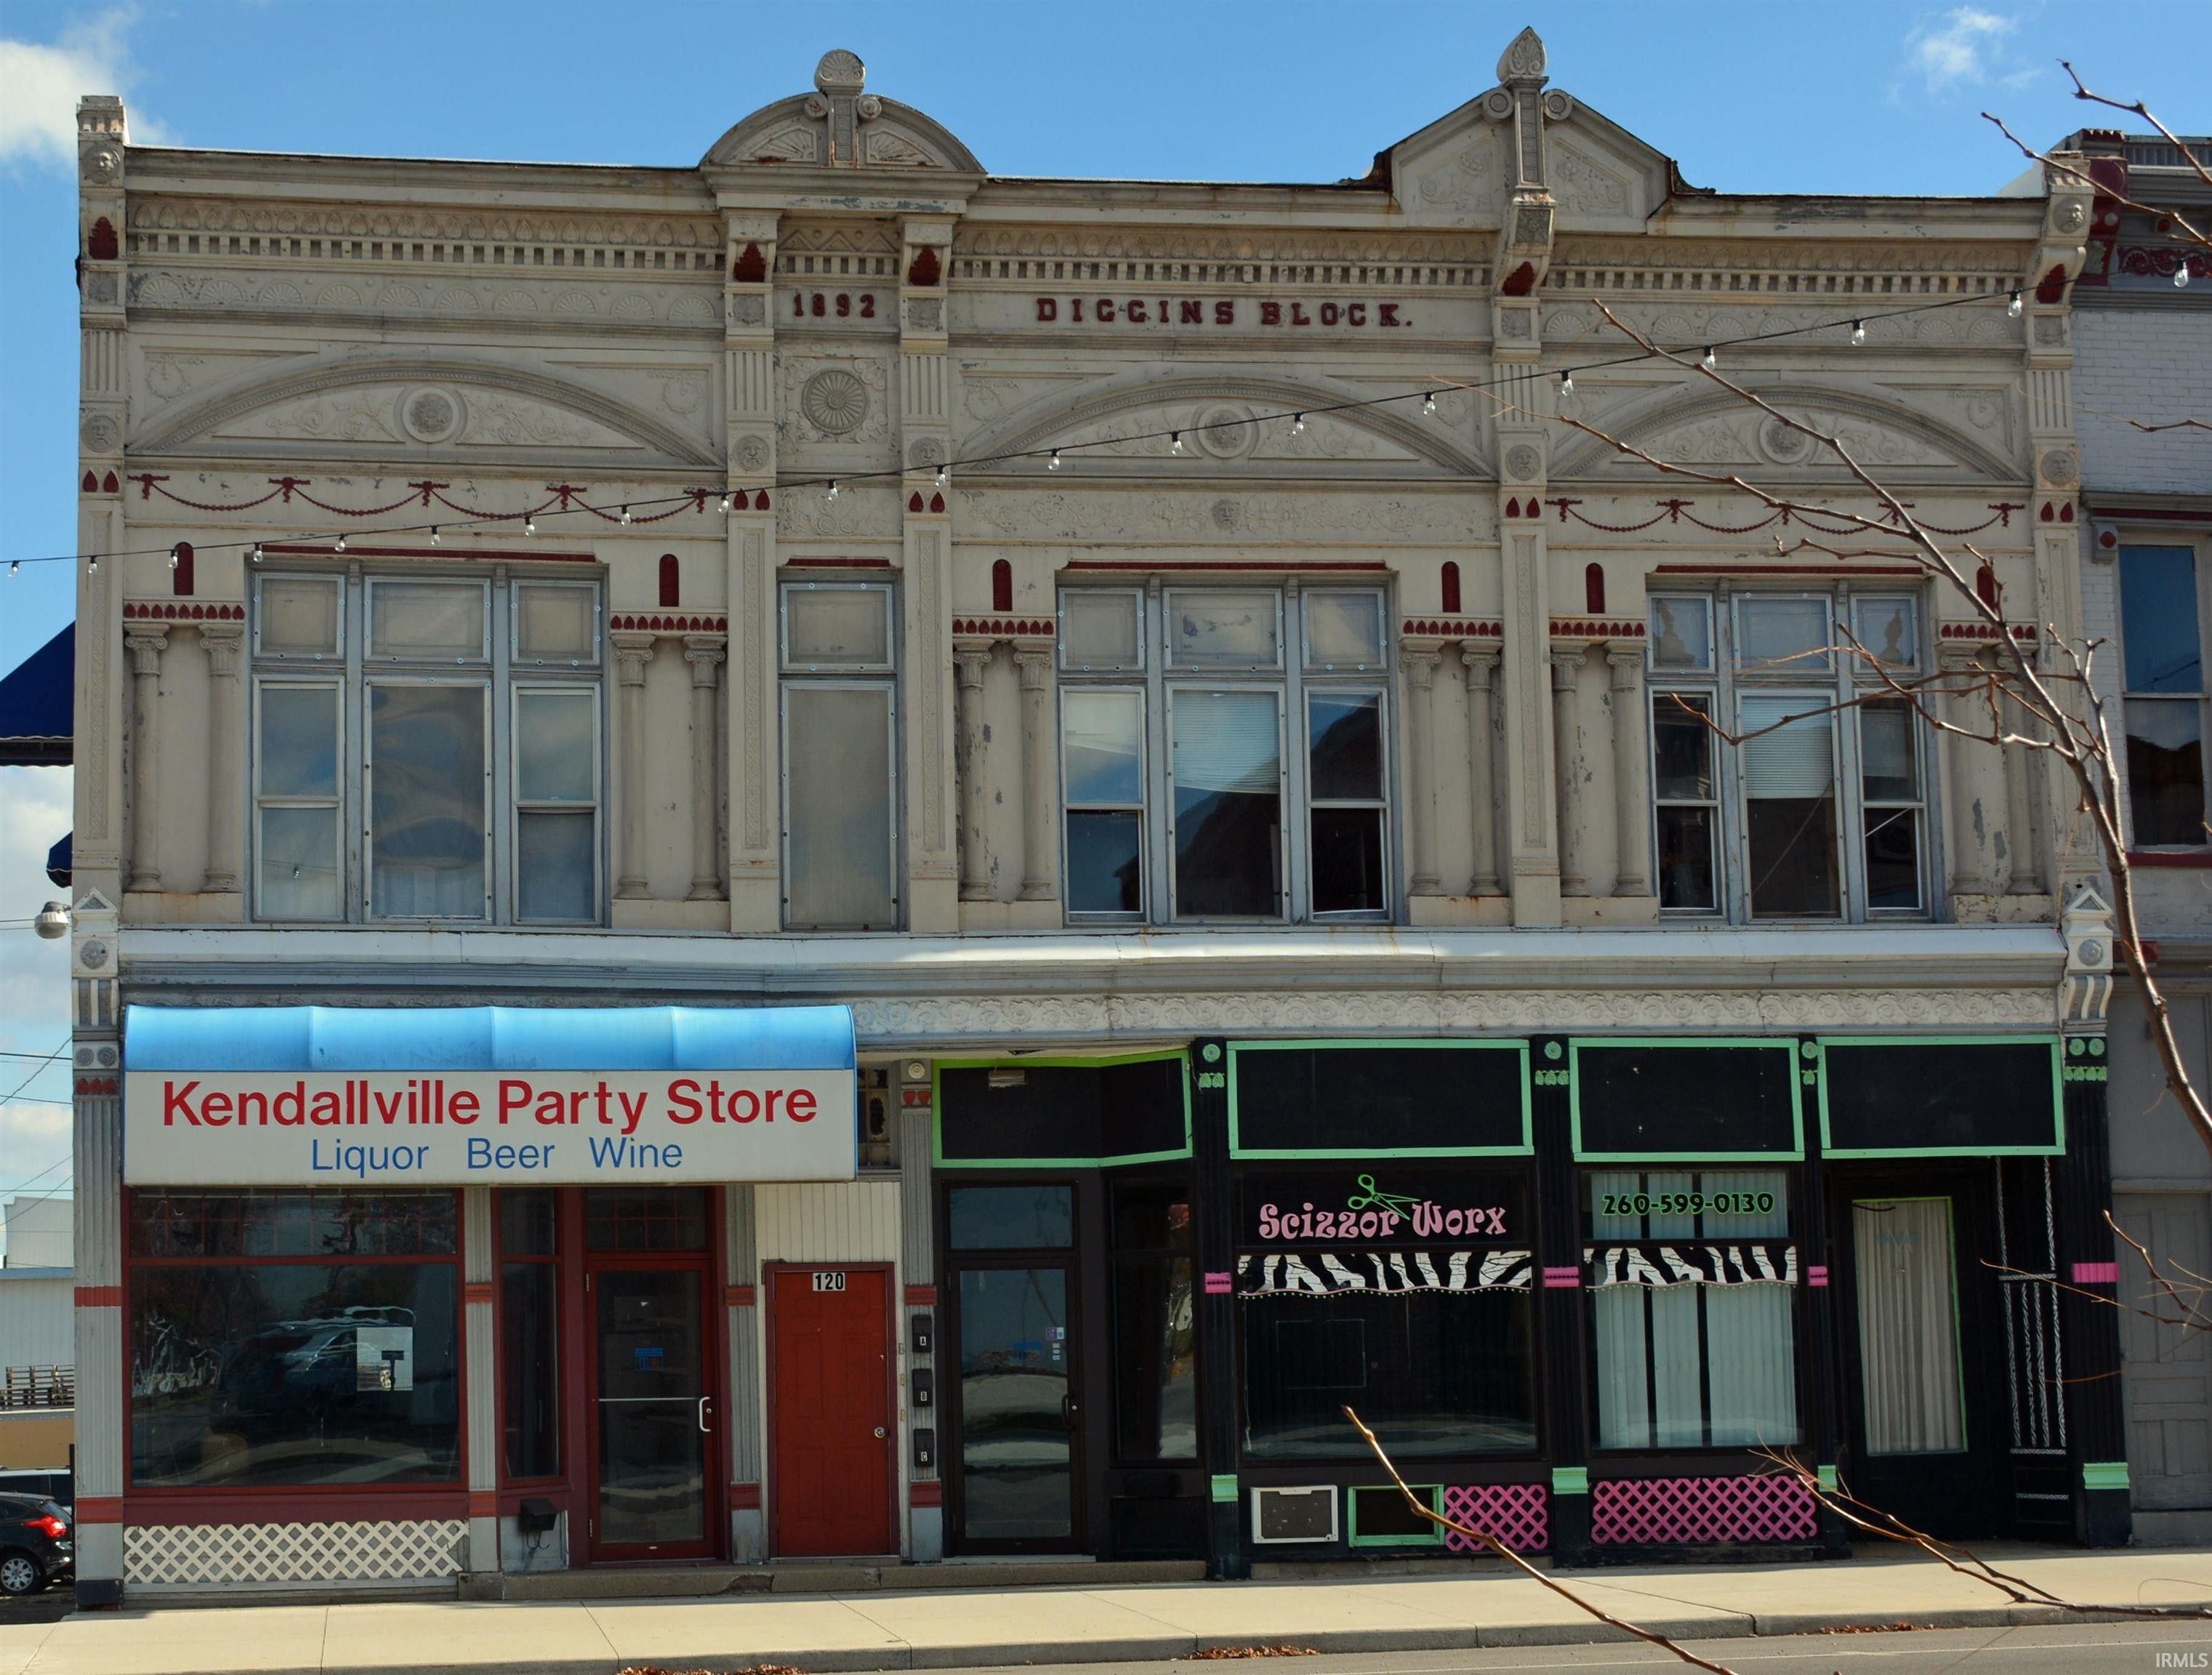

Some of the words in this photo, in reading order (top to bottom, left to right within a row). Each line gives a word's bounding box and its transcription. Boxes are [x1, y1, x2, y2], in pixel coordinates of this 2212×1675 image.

[794, 294, 877, 318] 1892
[1036, 297, 1235, 326] DIGGINS
[164, 1080, 481, 1128] Kendallville
[499, 1080, 648, 1136] Party
[668, 1079, 819, 1126] Store
[312, 1138, 430, 1179] Liquor
[467, 1138, 556, 1170] Beer
[590, 1137, 683, 1170] Wine
[1601, 1189, 1779, 1218] 260-599-0130
[1258, 1202, 1401, 1240] Scizzor
[1412, 1200, 1508, 1237] Worx
[815, 1273, 845, 1290] 120
[920, 1336, 926, 1346] A
[921, 1391, 927, 1401] B
